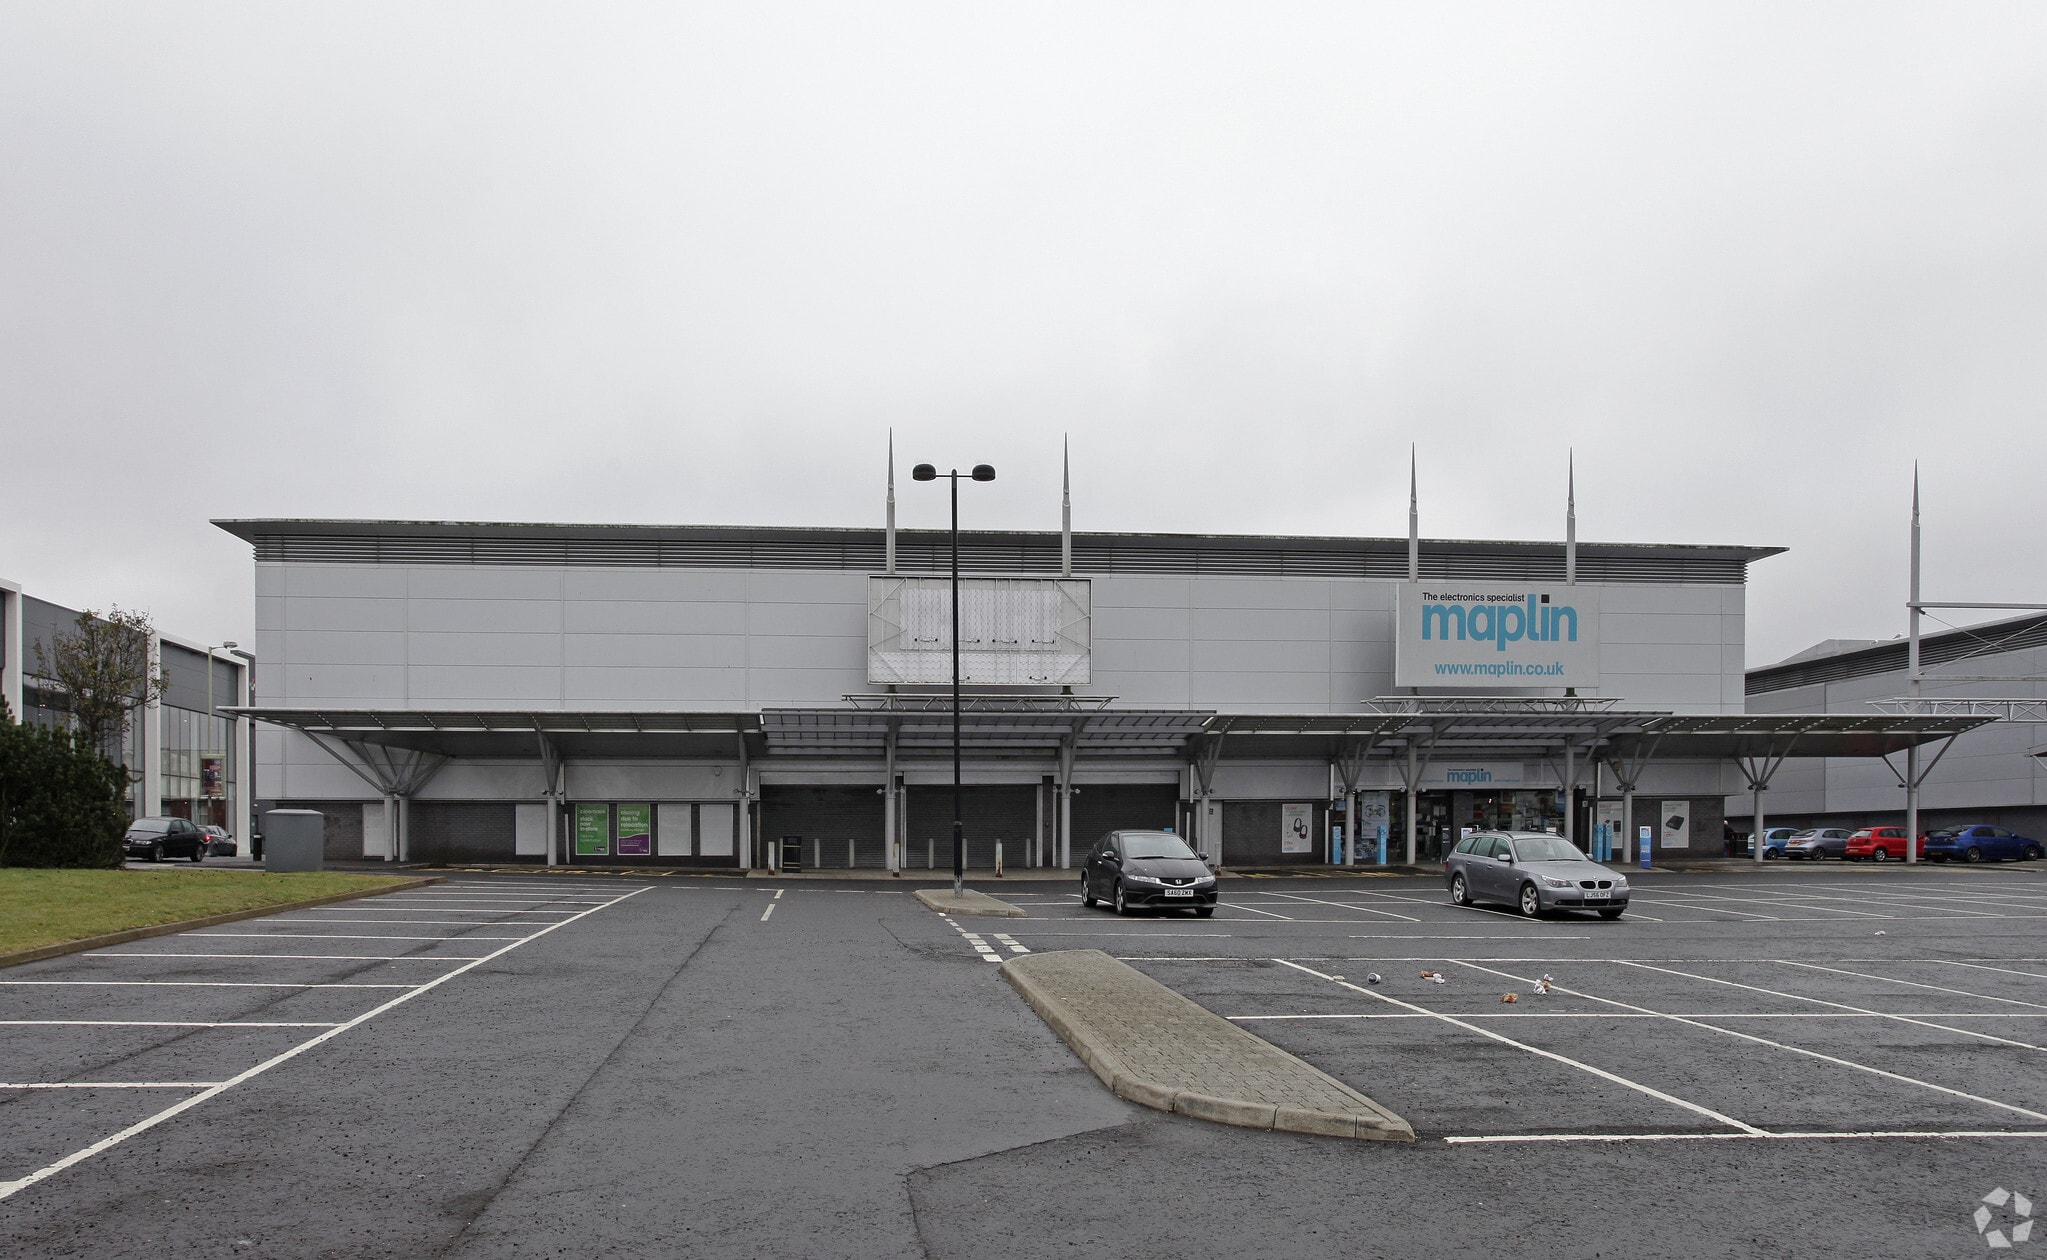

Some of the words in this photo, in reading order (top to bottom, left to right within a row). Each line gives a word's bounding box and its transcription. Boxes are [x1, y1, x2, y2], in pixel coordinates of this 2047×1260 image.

[1422, 592, 1438, 601] The
[1440, 592, 1485, 602] electronics
[1486, 592, 1525, 603] specialist
[1422, 594, 1577, 651] maplin
[1434, 660, 1565, 678] www.maplin.co.uk
[1446, 768, 1492, 785] maplin
